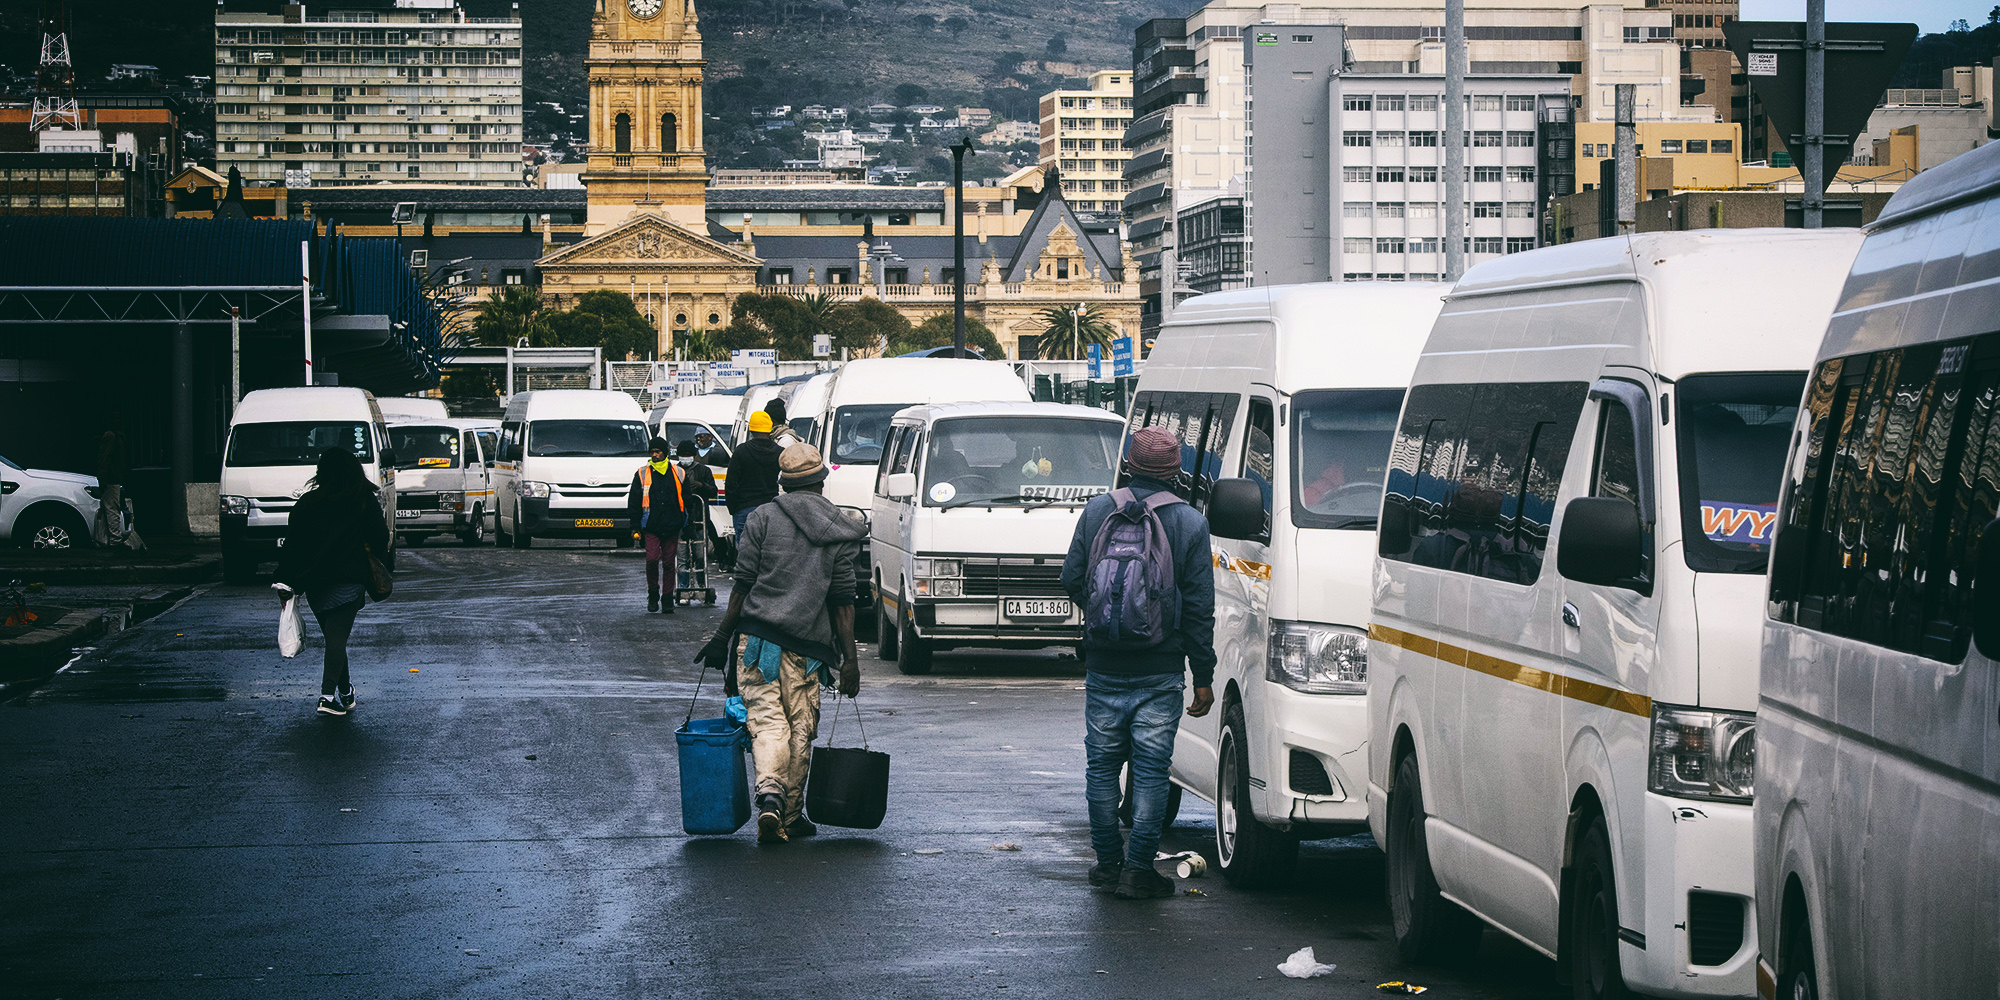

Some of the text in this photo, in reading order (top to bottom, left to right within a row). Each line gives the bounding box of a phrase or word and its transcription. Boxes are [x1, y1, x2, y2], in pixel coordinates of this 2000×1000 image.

[575, 519, 614, 527] CAA268409
[1700, 505, 1776, 539] WY
[1008, 601, 1021, 614] CA
